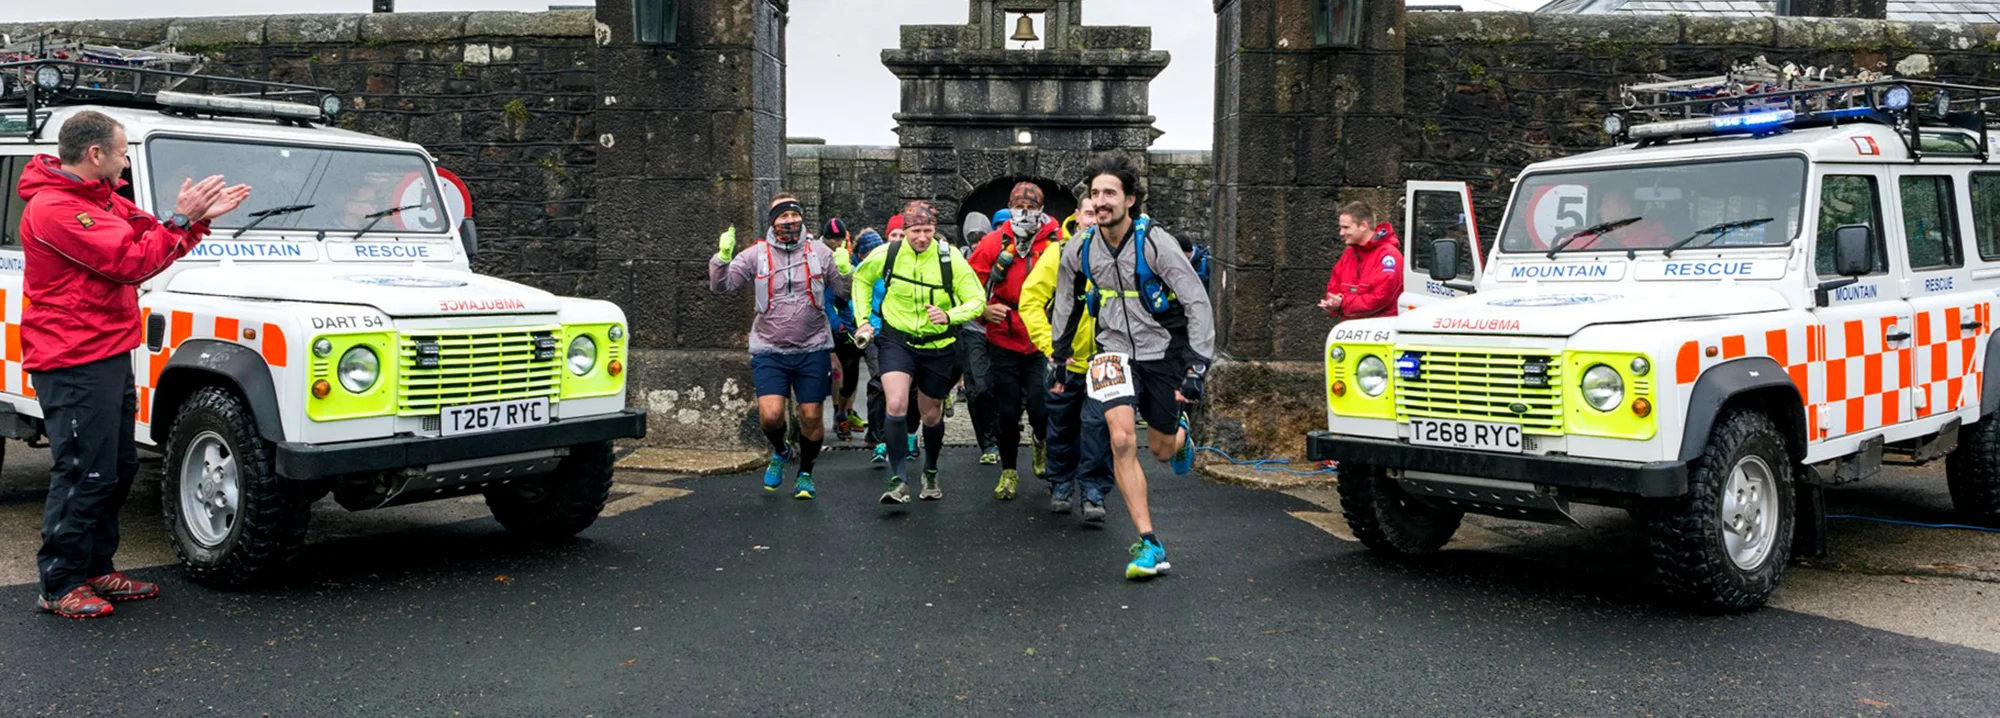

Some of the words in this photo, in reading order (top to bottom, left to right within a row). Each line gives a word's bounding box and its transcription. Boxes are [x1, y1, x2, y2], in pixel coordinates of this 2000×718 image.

[1554, 196, 1584, 237] 5
[191, 243, 301, 257] MOUNTAIN
[355, 245, 429, 257] RESCUE
[1510, 265, 1608, 278] MOUNTAIN
[1663, 262, 1753, 276] RESCUE
[1426, 281, 1455, 297] RESCUE
[1835, 284, 1877, 301] MOUNTAIN
[1925, 277, 1953, 292] RESCUE
[311, 316, 357, 329] DART
[363, 315, 384, 328] 54
[1335, 329, 1372, 341] DART
[1374, 330, 1391, 342] 64
[1096, 361, 1118, 382] 76
[450, 406, 501, 431] T267
[507, 402, 542, 425] RYC
[1411, 420, 1467, 443] T268
[1475, 424, 1520, 448] RYC
